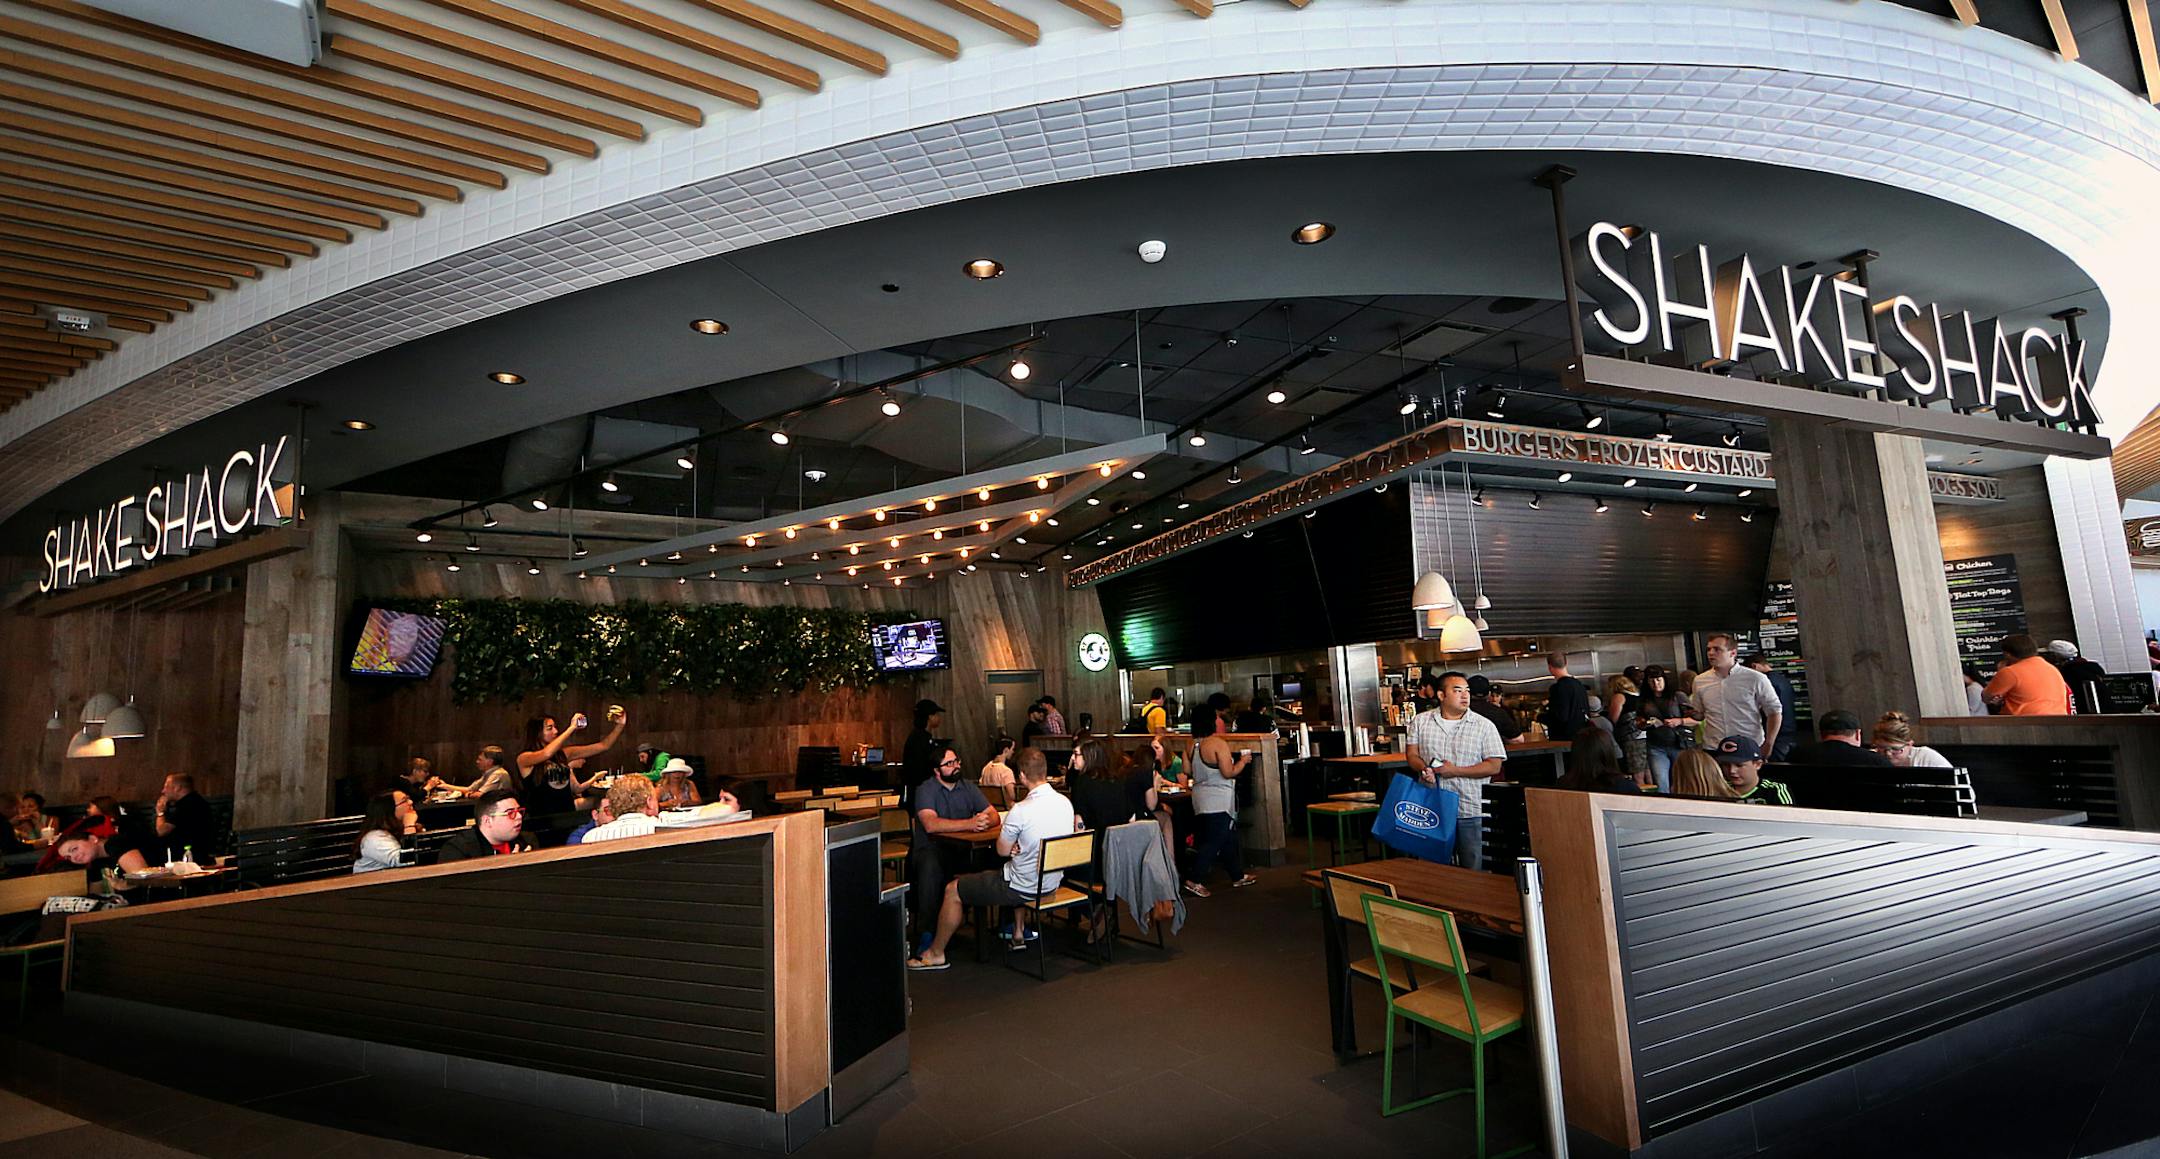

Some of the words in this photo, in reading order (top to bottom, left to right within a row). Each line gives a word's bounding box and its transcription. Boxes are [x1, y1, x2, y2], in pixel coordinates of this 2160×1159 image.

[1587, 221, 1886, 388] SHAKE
[1893, 295, 2103, 425] SHACK
[1463, 424, 1579, 460] BURGERS
[1587, 438, 1677, 471] FROZEN
[1678, 448, 1768, 479] CUSTARD
[39, 495, 135, 593] SHAKE
[140, 434, 287, 561] SHACK
[1955, 561, 1993, 571] Chicken
[1987, 587, 2012, 596] Dogs
[1404, 803, 1431, 818] STEVE
[1399, 811, 1431, 828] MADDEN
